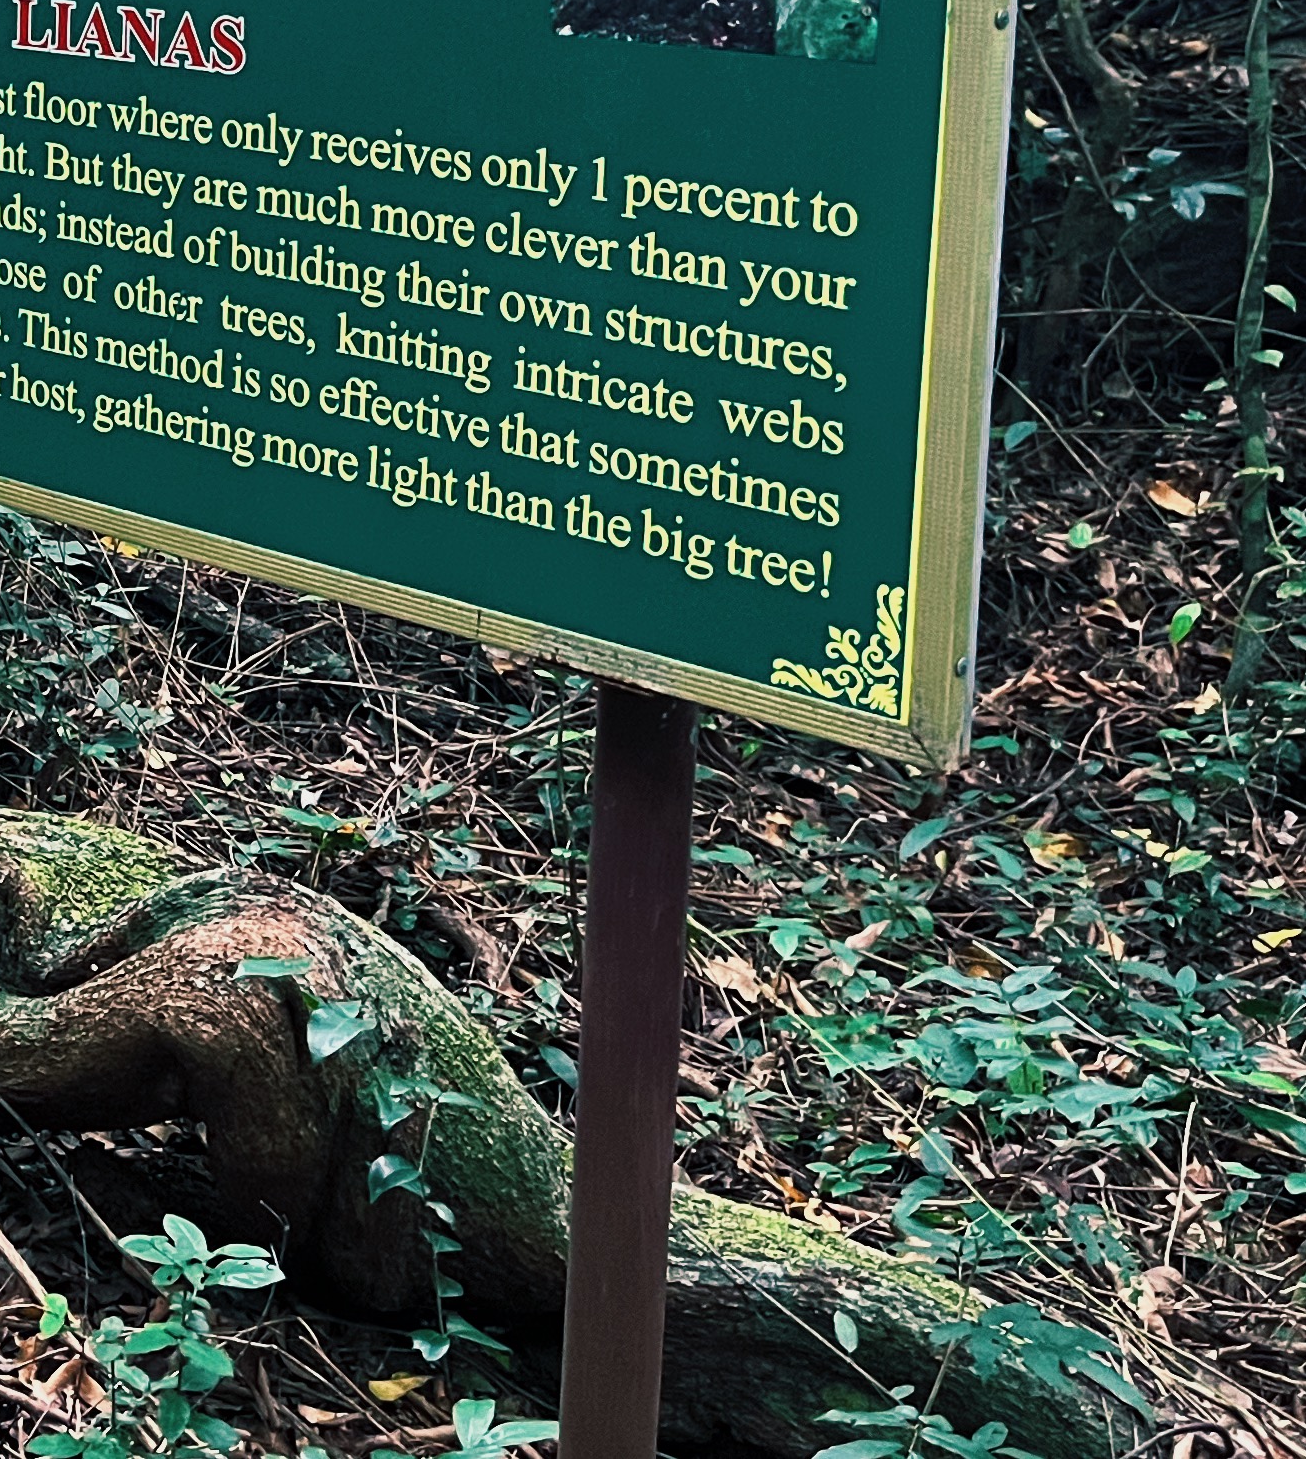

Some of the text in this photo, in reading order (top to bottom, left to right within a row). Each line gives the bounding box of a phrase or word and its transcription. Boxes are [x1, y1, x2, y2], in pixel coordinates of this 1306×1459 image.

[24, 82, 101, 127] floor
[107, 96, 212, 143] where
[222, 113, 303, 166] only
[310, 129, 471, 181] receives
[482, 148, 577, 206] only
[592, 157, 607, 201] 1
[621, 175, 799, 228] percent
[810, 191, 857, 236] to
[44, 142, 103, 186] But
[112, 153, 185, 209] they
[194, 176, 247, 210] are
[256, 186, 361, 229] much
[371, 204, 474, 247] more
[486, 212, 619, 270] clever
[629, 232, 727, 289] than
[740, 261, 856, 309] your
[57, 201, 174, 258] instead
[184, 227, 225, 266] of
[230, 231, 386, 307] building
[396, 261, 490, 315] their
[500, 292, 593, 336] own
[606, 305, 846, 392] structures,
[64, 265, 102, 303] of
[115, 276, 203, 323] other
[221, 296, 315, 354] trees,
[336, 312, 492, 393] knitting
[514, 346, 693, 423] intricate
[719, 400, 843, 454] webs
[10, 363, 85, 423] host,
[93, 394, 255, 466] gathering
[262, 434, 358, 481] more
[367, 446, 457, 506] light
[465, 472, 555, 530] than
[565, 495, 631, 547] the
[642, 508, 715, 579] big
[725, 535, 831, 598] tree!
[19, 309, 87, 358] This
[95, 337, 224, 388] method
[232, 353, 260, 397] is
[270, 374, 309, 407] so
[320, 378, 489, 447] effective
[499, 412, 579, 468] that
[589, 443, 839, 526] sometimes
